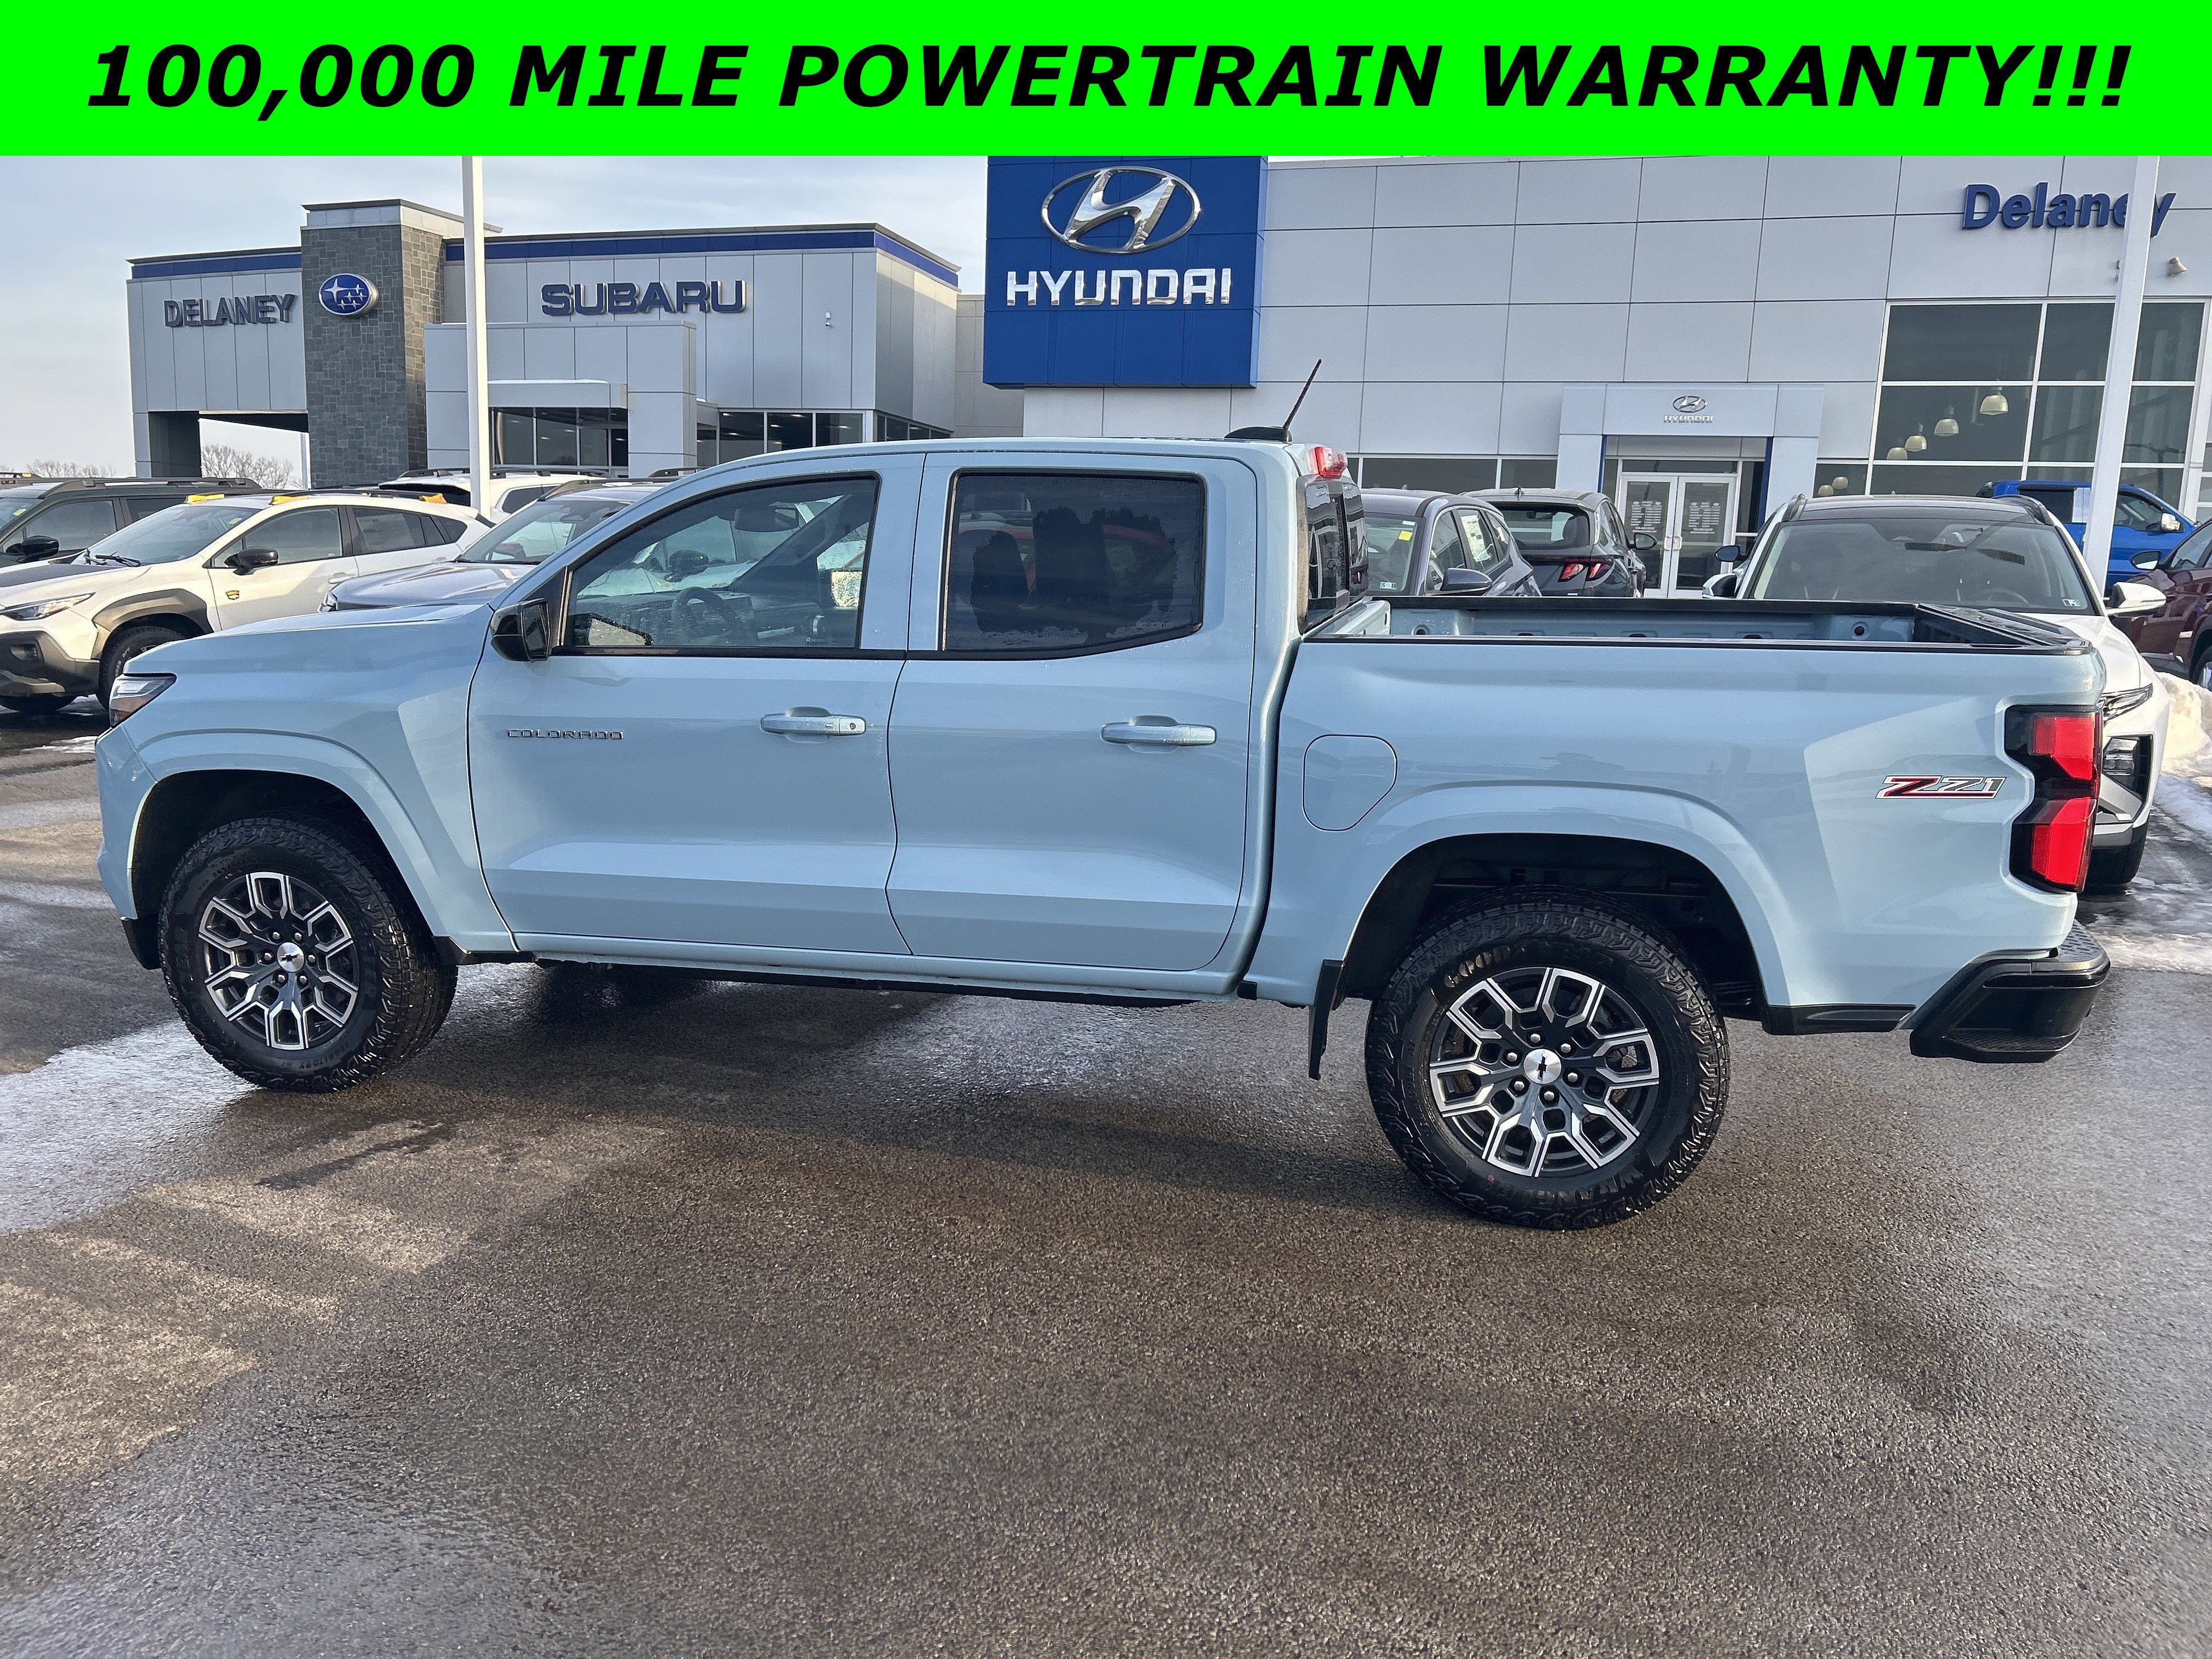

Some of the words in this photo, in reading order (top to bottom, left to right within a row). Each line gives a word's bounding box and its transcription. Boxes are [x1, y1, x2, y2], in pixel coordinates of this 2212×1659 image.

[541, 279, 747, 315] SUBARU
[1006, 268, 1232, 306] HYUNDAI
[164, 294, 294, 328] DELANEY
[1663, 415, 1713, 424] HYUNDAI
[507, 729, 624, 740] COLORADO
[1875, 775, 2007, 799] Z71
